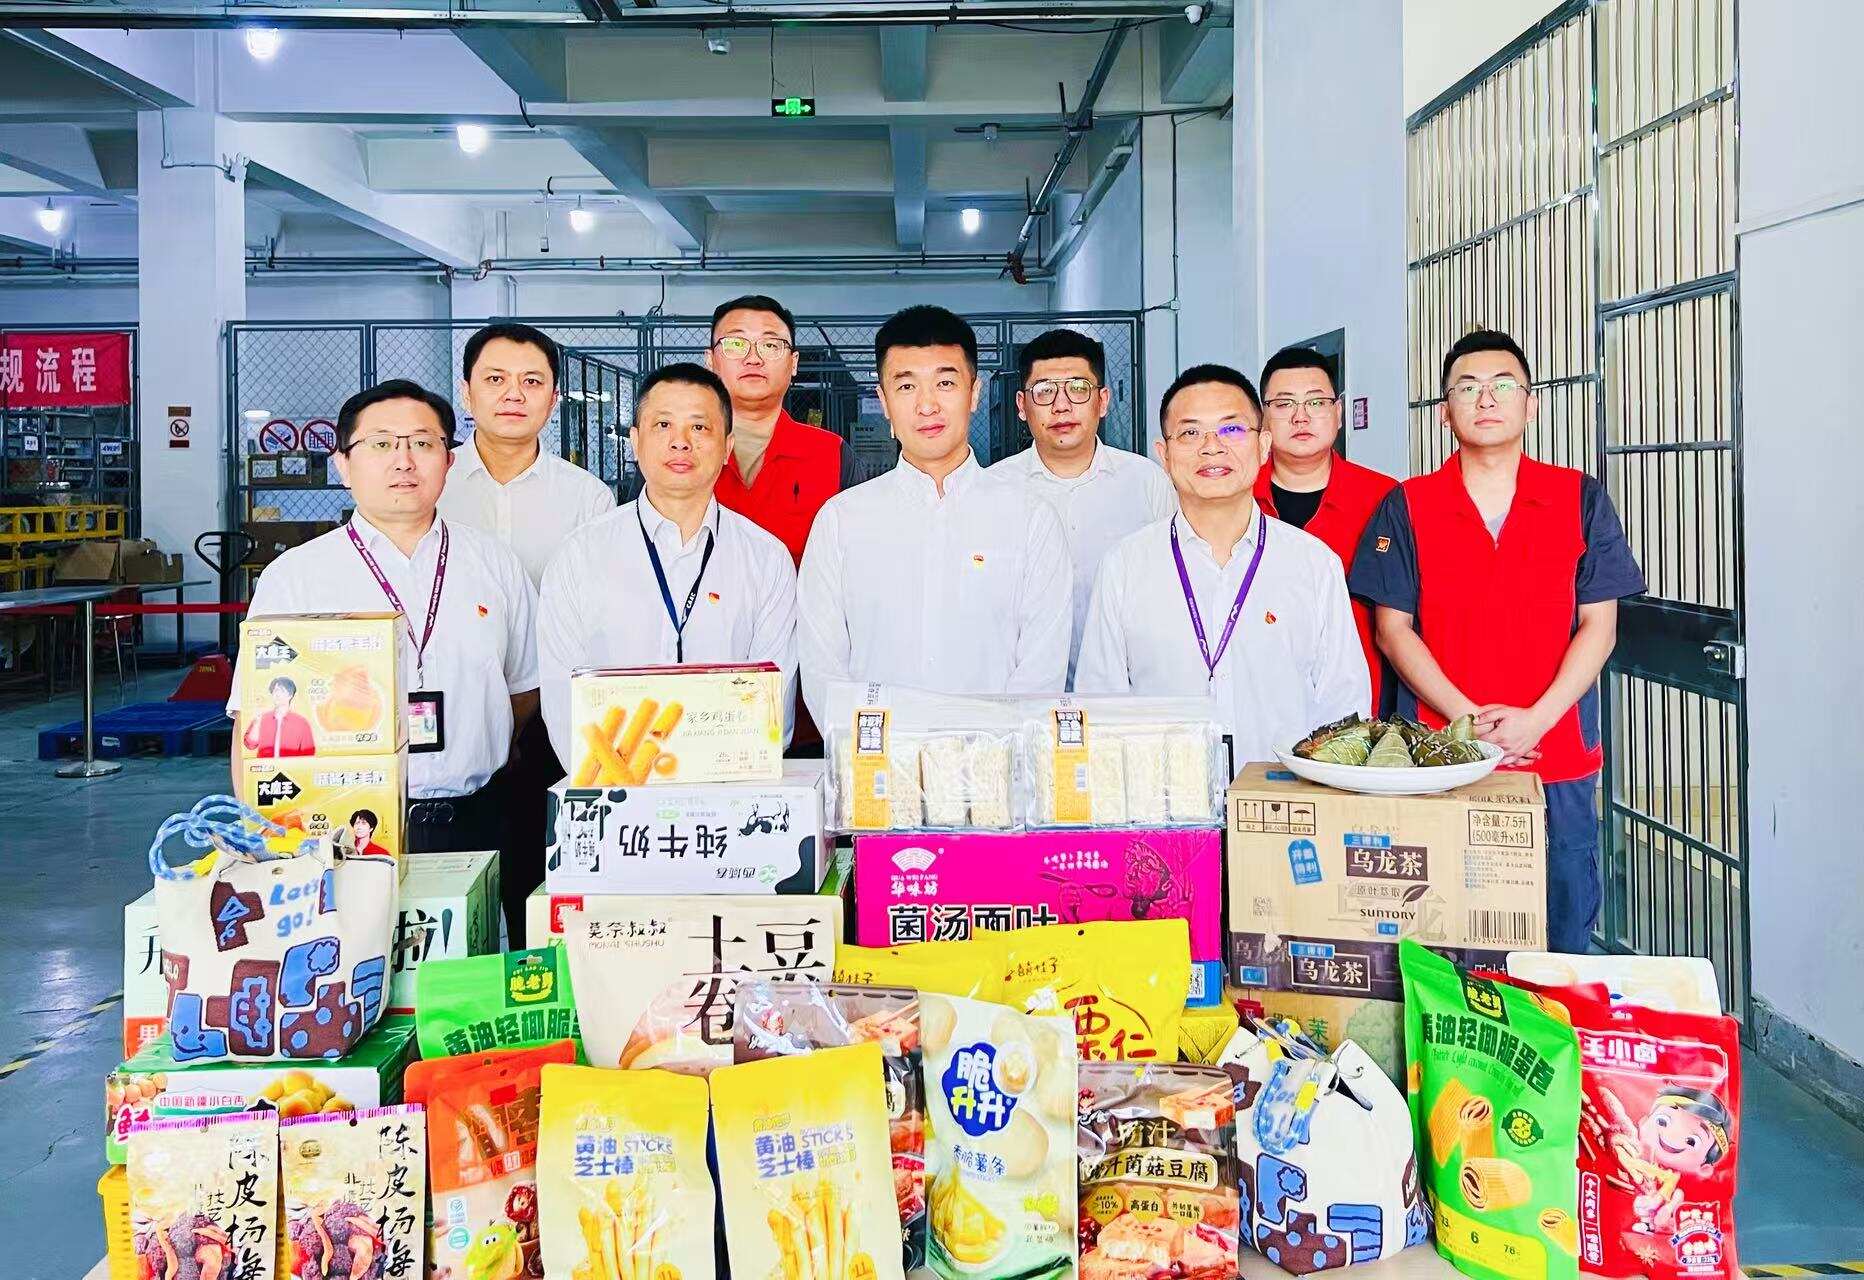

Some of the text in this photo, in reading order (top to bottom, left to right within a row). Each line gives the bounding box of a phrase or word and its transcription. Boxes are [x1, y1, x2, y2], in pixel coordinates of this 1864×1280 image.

[0, 347, 97, 394] 规流程
[259, 781, 294, 796] 大魔王
[618, 824, 729, 859] 纯牛奶
[1350, 848, 1424, 877] 乌龙茶
[276, 904, 315, 938] go!
[589, 918, 668, 939] 莫奈叔叔
[1297, 958, 1364, 984] 乌龙茶
[957, 1049, 993, 1092] 脆
[158, 1094, 246, 1107] 中国新疆小白杏
[755, 1127, 854, 1157] 黄油 STICKS
[574, 1155, 634, 1177] 芝士棒
[756, 1149, 816, 1179] 芝士棒
[1130, 1199, 1160, 1213] 高蛋白
[1470, 1230, 1480, 1244] 6
